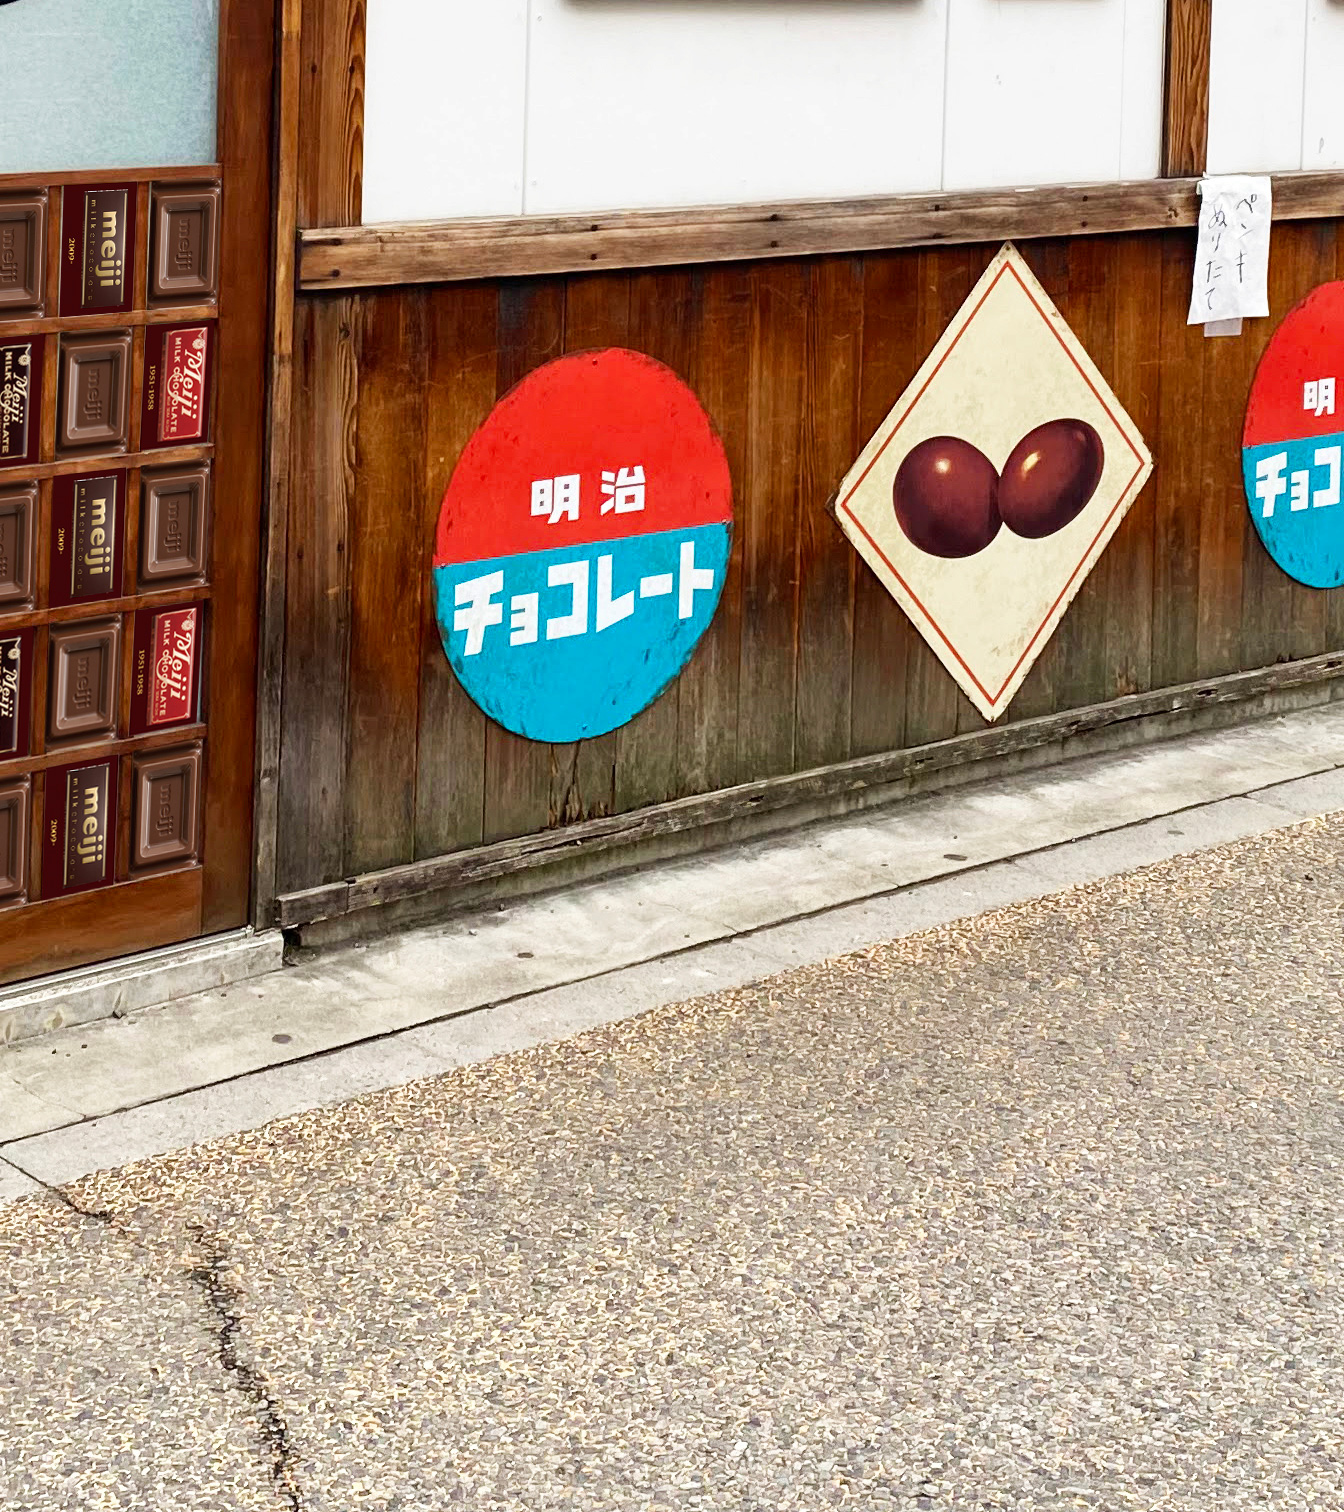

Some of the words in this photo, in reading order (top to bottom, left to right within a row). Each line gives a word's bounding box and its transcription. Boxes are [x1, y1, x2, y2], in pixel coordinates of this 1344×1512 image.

[94, 210, 122, 288] meiji
[1205, 204, 1227, 310] ぬりたて
[1236, 193, 1257, 283] ペンキ
[167, 348, 203, 420] Meiji
[174, 336, 182, 363] MILK
[530, 465, 647, 524] 明治
[84, 498, 112, 575] meiji
[163, 619, 171, 646] MILK
[453, 540, 716, 656] チョコレート
[156, 631, 192, 702] Meiji
[76, 786, 104, 864] meiji
